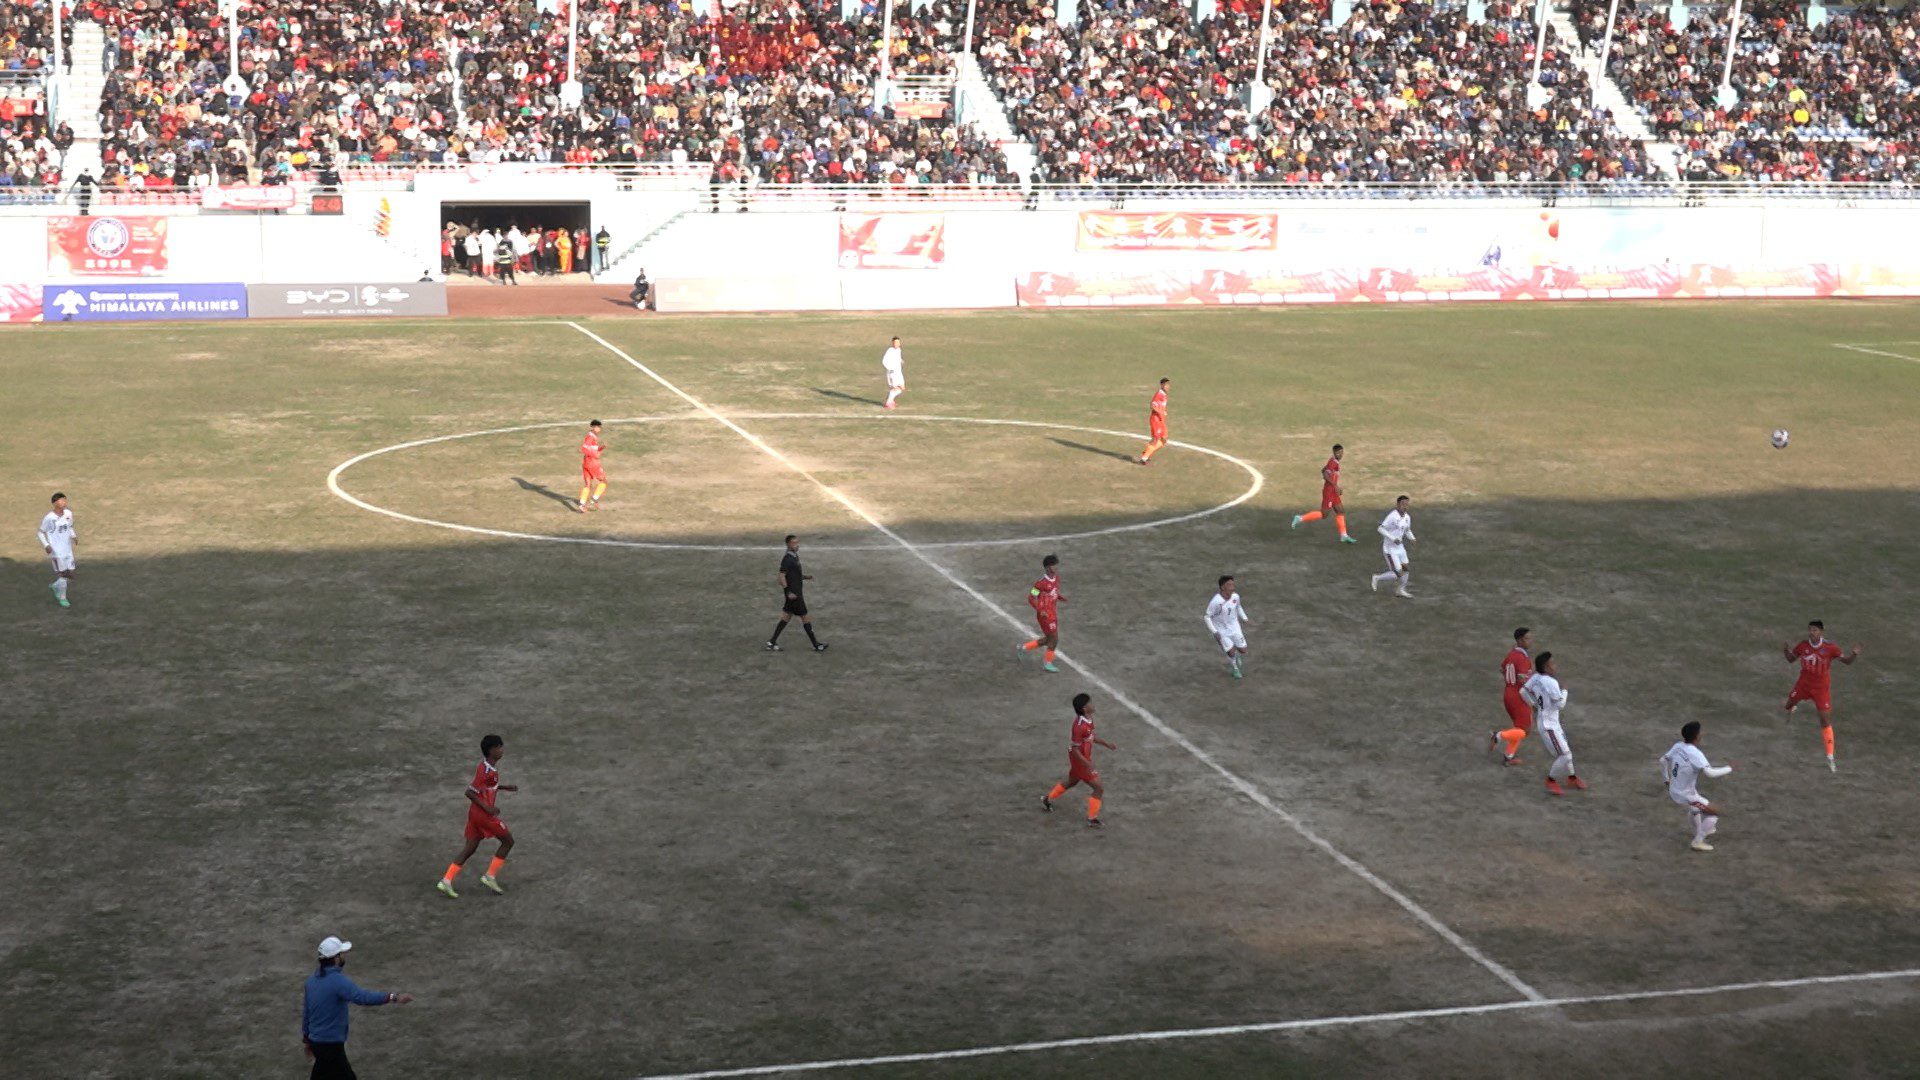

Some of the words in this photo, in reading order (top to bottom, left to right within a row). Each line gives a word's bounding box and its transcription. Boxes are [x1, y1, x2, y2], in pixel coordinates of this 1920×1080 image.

[286, 289, 350, 304] BYD
[90, 301, 165, 312] HIMALAYA
[171, 300, 240, 312] AIRLINES
[1505, 663, 1516, 685] 10
